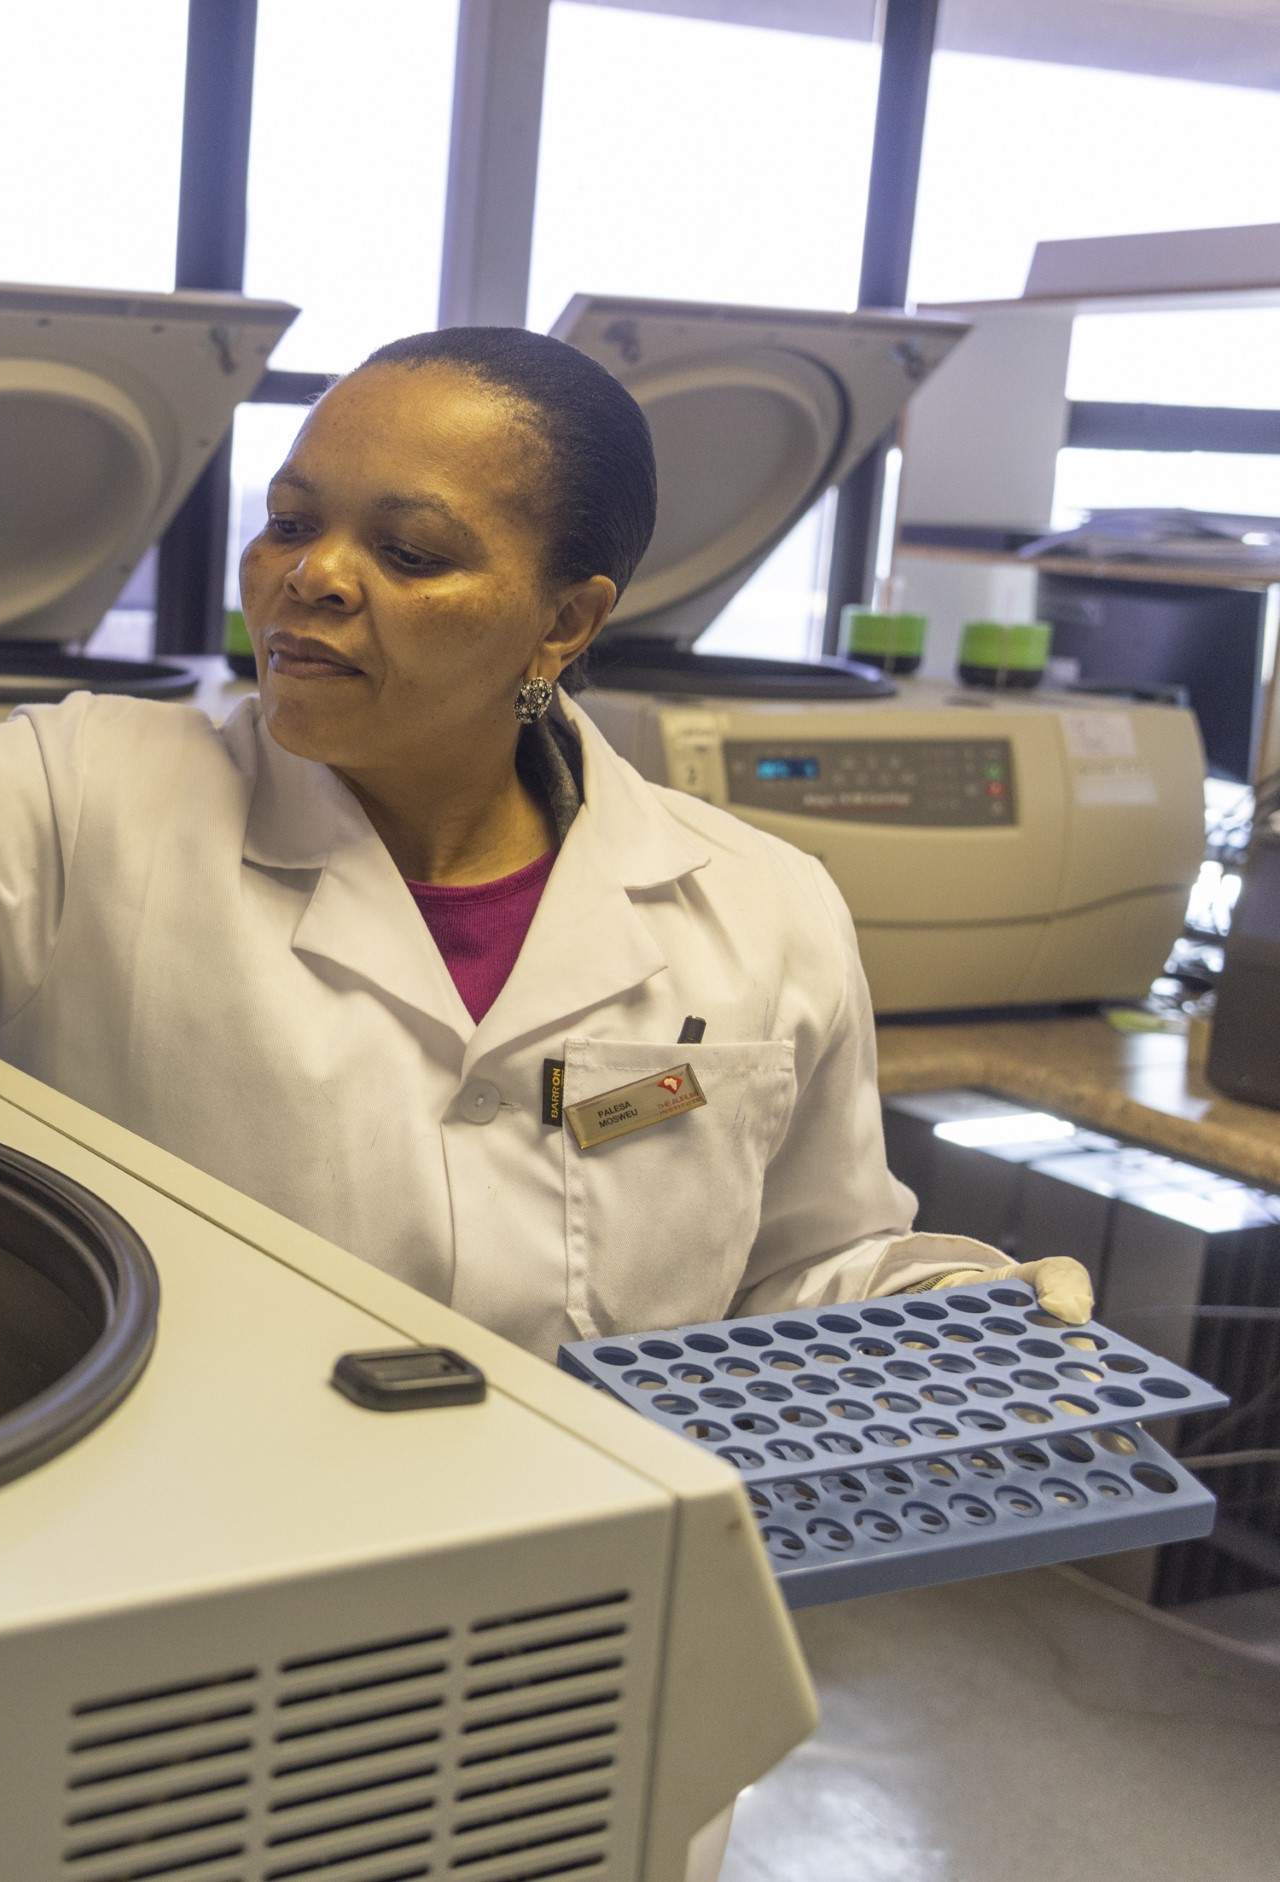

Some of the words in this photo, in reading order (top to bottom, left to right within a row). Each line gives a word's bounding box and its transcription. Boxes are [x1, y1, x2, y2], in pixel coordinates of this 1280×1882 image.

[551, 1067, 561, 1119] BARRON
[597, 1101, 632, 1118] PALESA
[598, 1108, 638, 1128] MOSWEU
